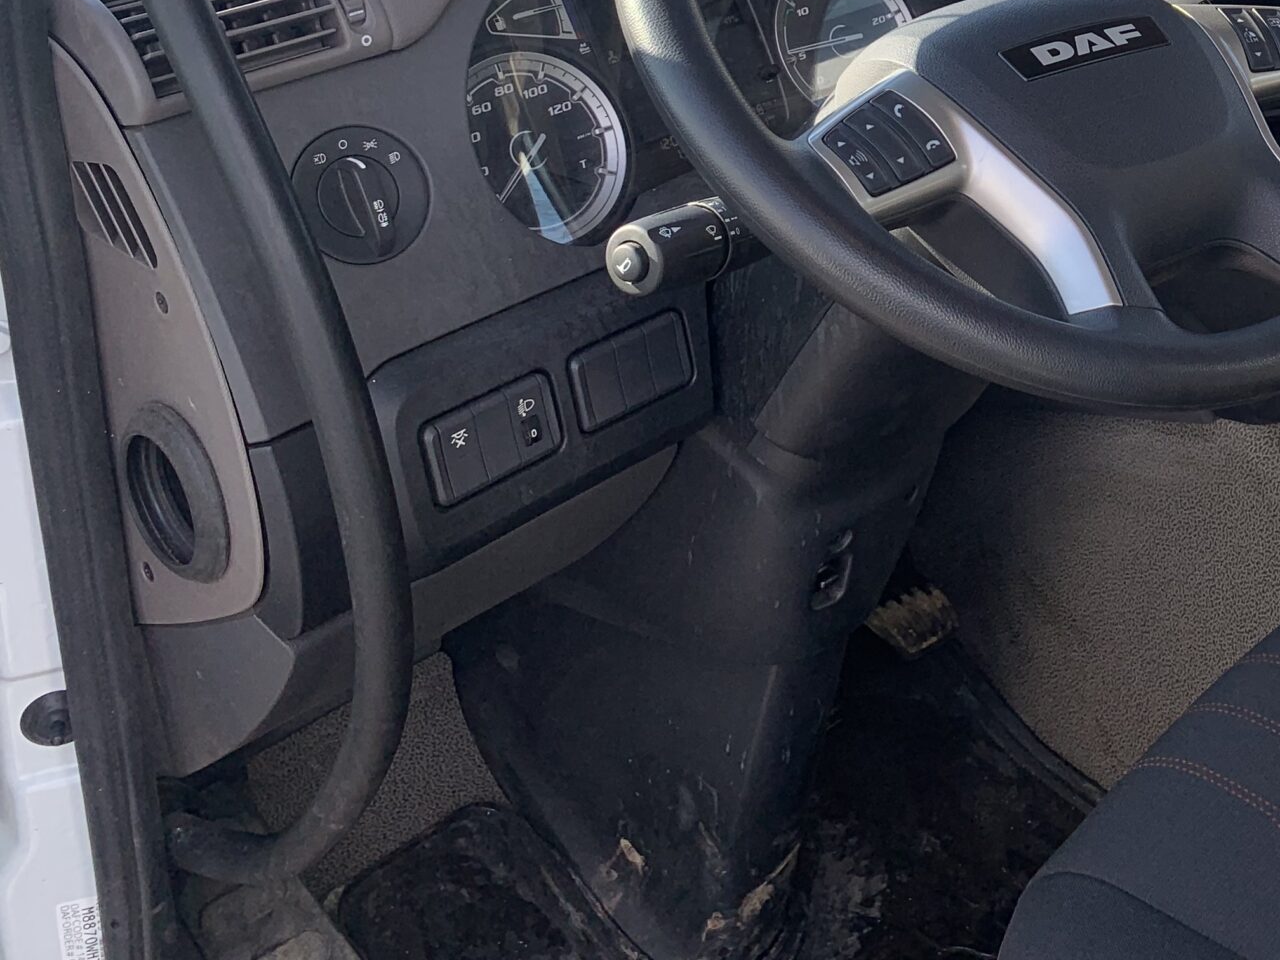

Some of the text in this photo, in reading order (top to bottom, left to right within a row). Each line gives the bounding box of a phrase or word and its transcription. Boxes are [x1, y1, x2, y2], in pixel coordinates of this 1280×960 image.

[796, 7, 809, 16] 10
[872, 16, 886, 26] 20
[1030, 23, 1142, 66] DAF
[798, 52, 806, 60] 5
[494, 83, 514, 97] 80
[523, 84, 548, 99] 100
[472, 102, 492, 116] 60
[548, 101, 572, 116] 120
[580, 159, 588, 168] T
[60, 904, 70, 920] DAF
[62, 922, 74, 951] ORDER
[72, 920, 83, 942] CODE
[82, 906, 100, 960] M8870WH
